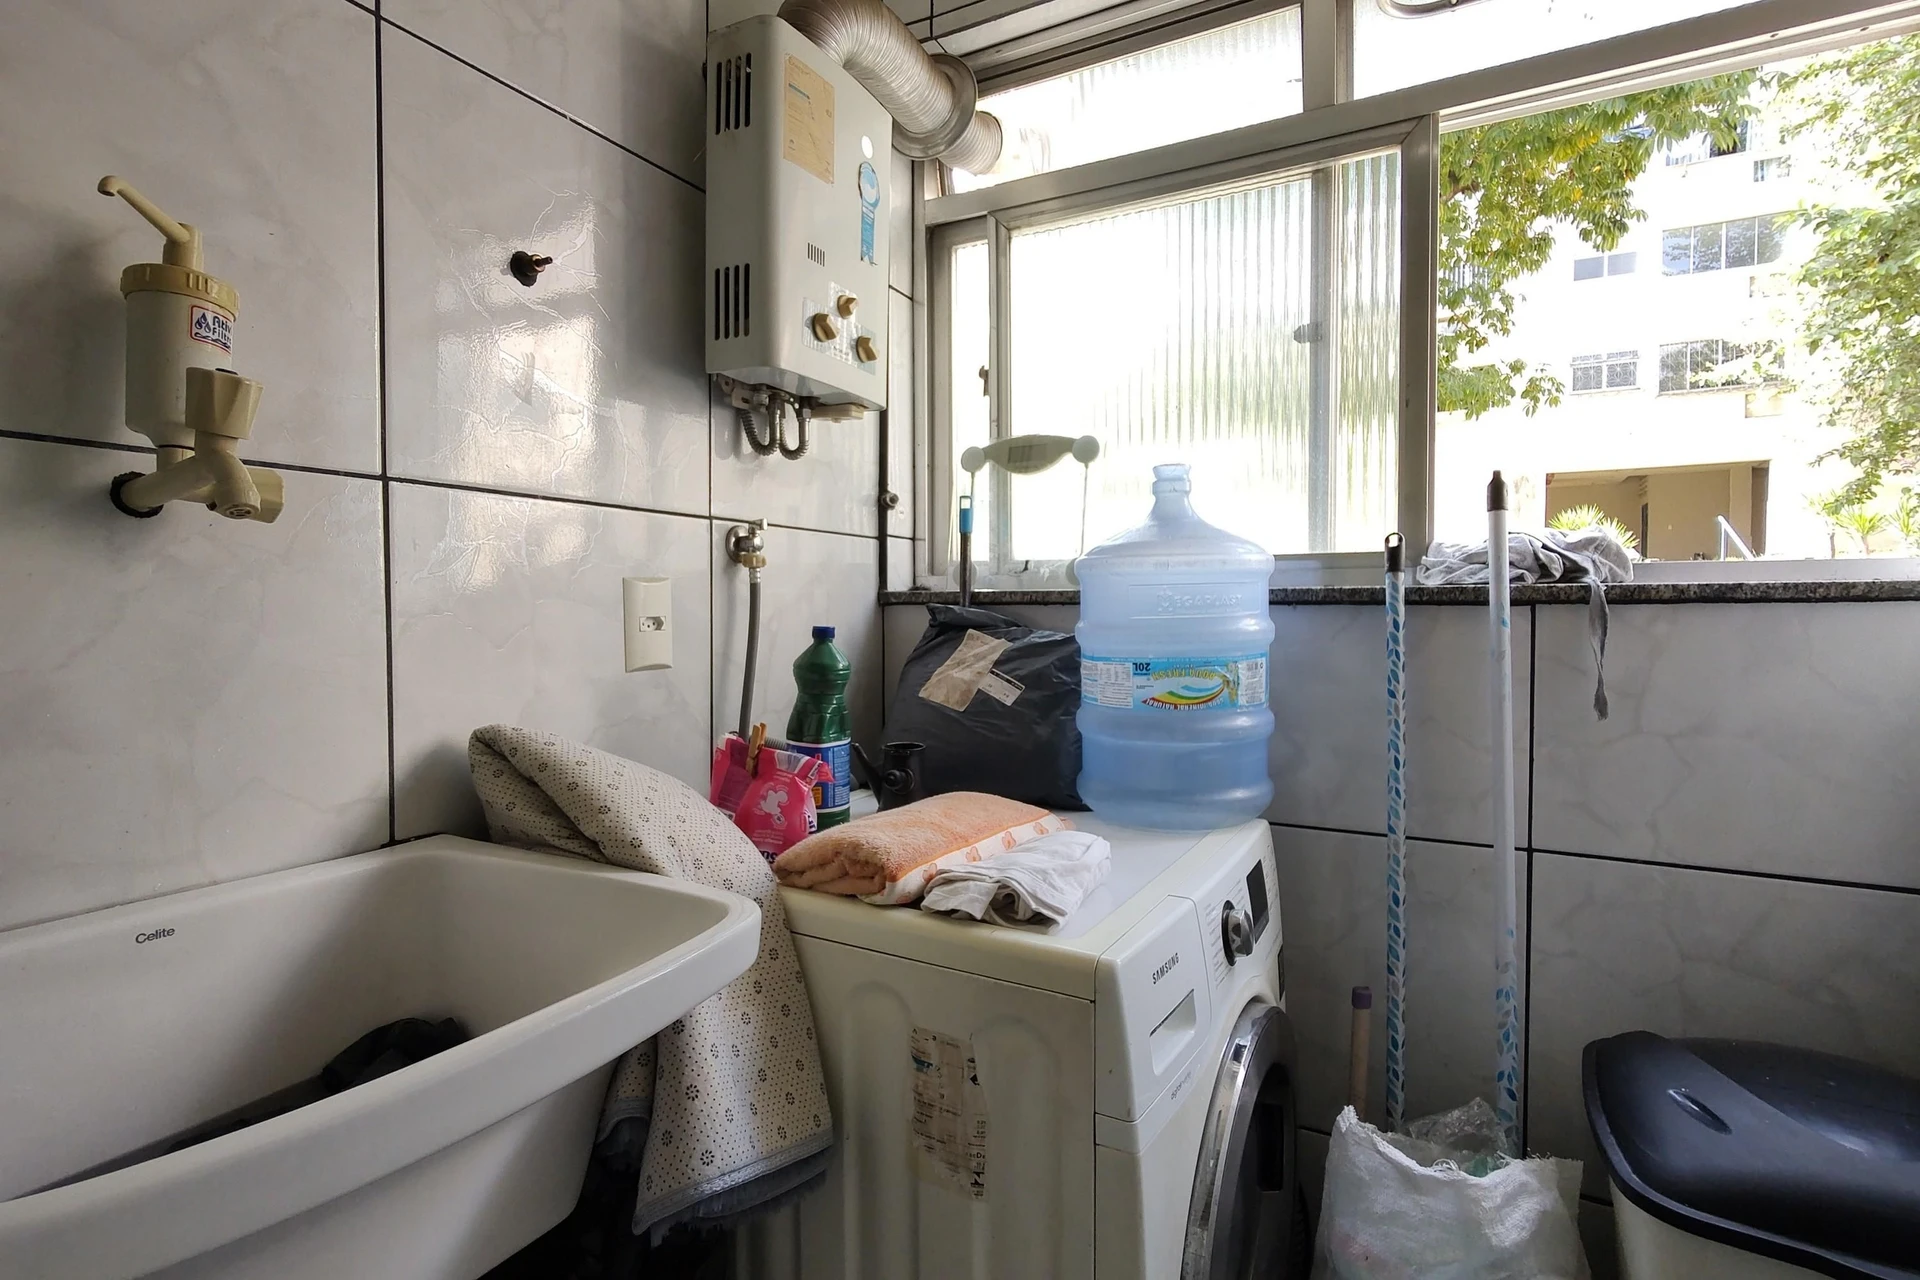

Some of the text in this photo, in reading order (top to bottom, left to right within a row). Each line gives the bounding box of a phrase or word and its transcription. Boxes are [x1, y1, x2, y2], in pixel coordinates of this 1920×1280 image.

[1133, 662, 1151, 672] 20L
[1151, 667, 1186, 681] FRESH
[135, 928, 176, 944] Celite
[1152, 952, 1179, 985] SAMSUNG
